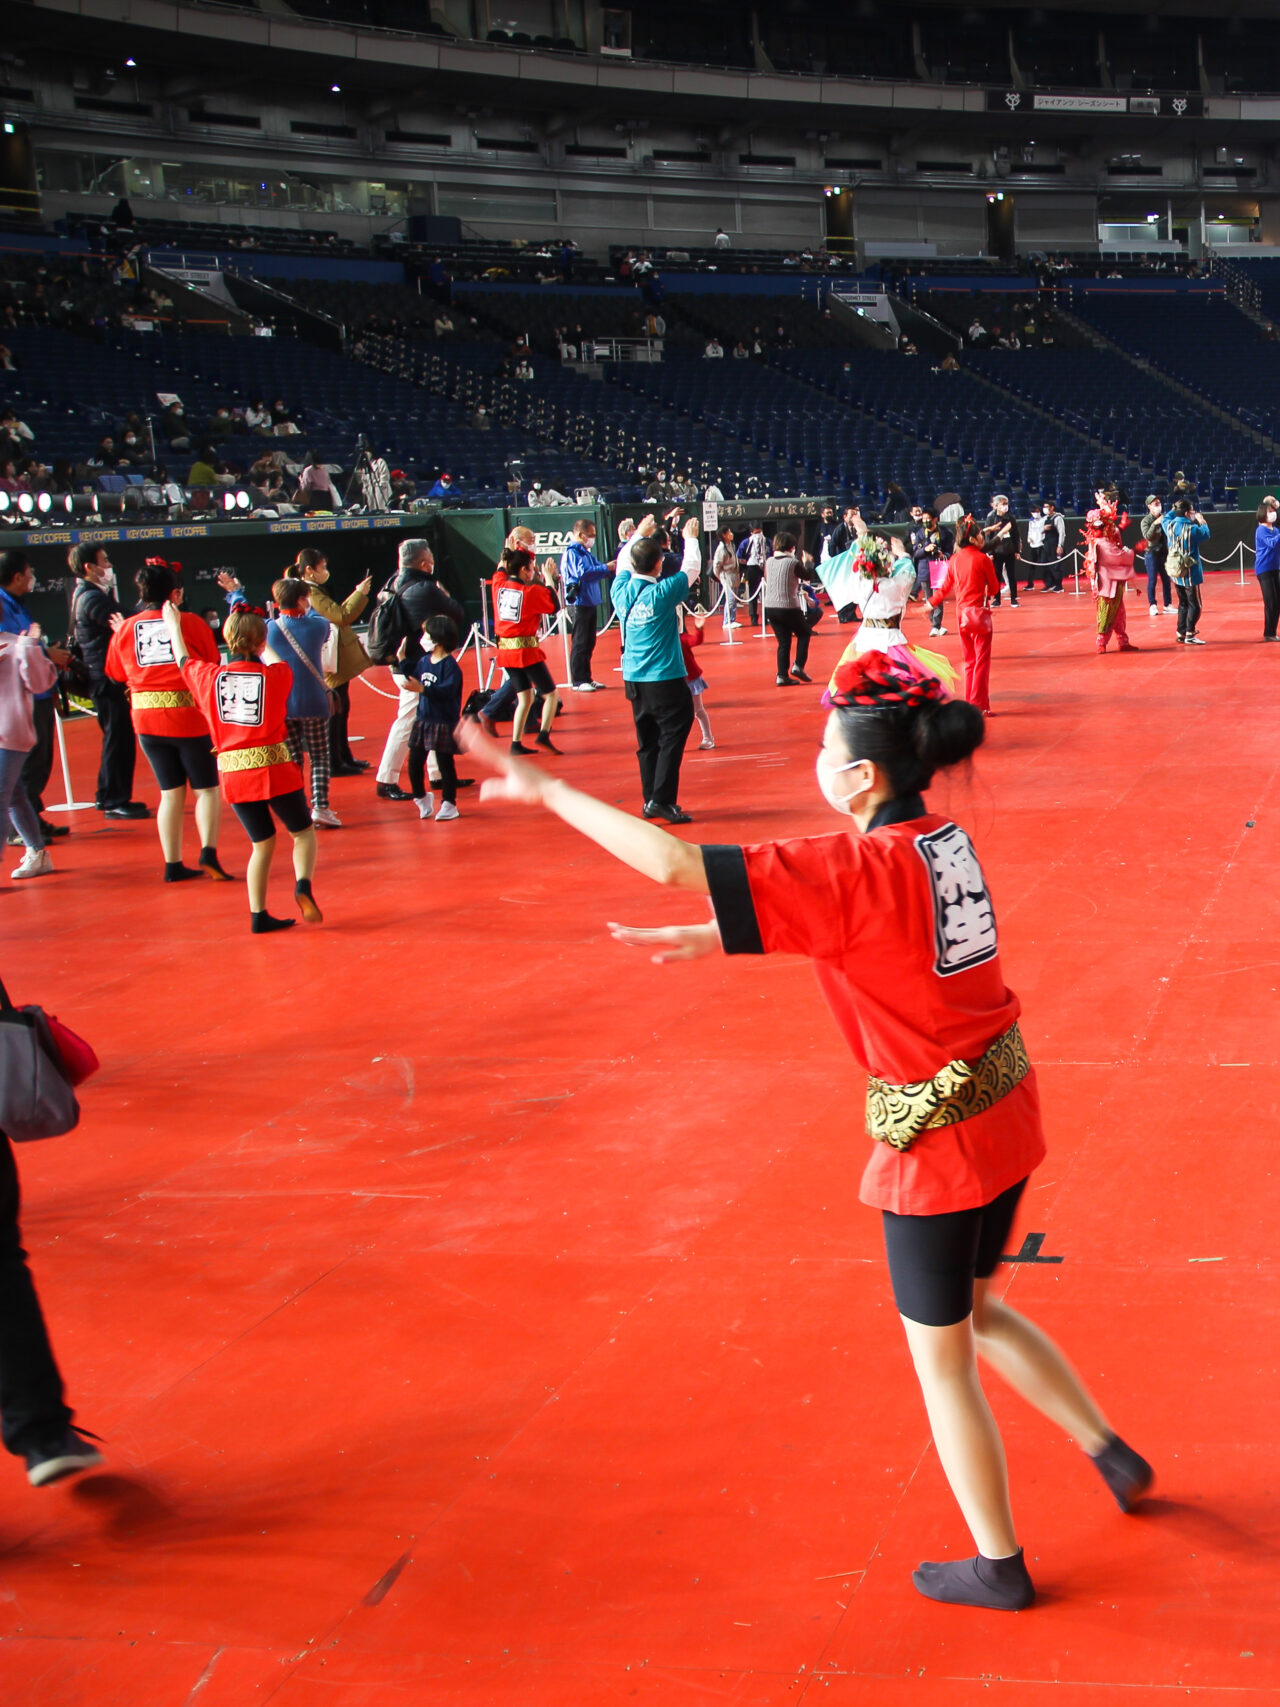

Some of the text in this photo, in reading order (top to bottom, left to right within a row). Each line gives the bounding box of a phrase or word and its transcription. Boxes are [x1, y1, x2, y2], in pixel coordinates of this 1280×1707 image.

[1038, 98, 1121, 108] ジャイアンツ シーズンシート
[317, 521, 336, 530] COFFEE
[351, 520, 369, 528] COFFEE
[383, 518, 400, 526] COFFEE
[171, 526, 207, 537] KEY COFFEE
[281, 523, 301, 532] COFFEE
[27, 532, 72, 544] KEY COFFEE
[78, 530, 120, 542] KEY COFFEE
[126, 528, 164, 539] KEY COFFEE
